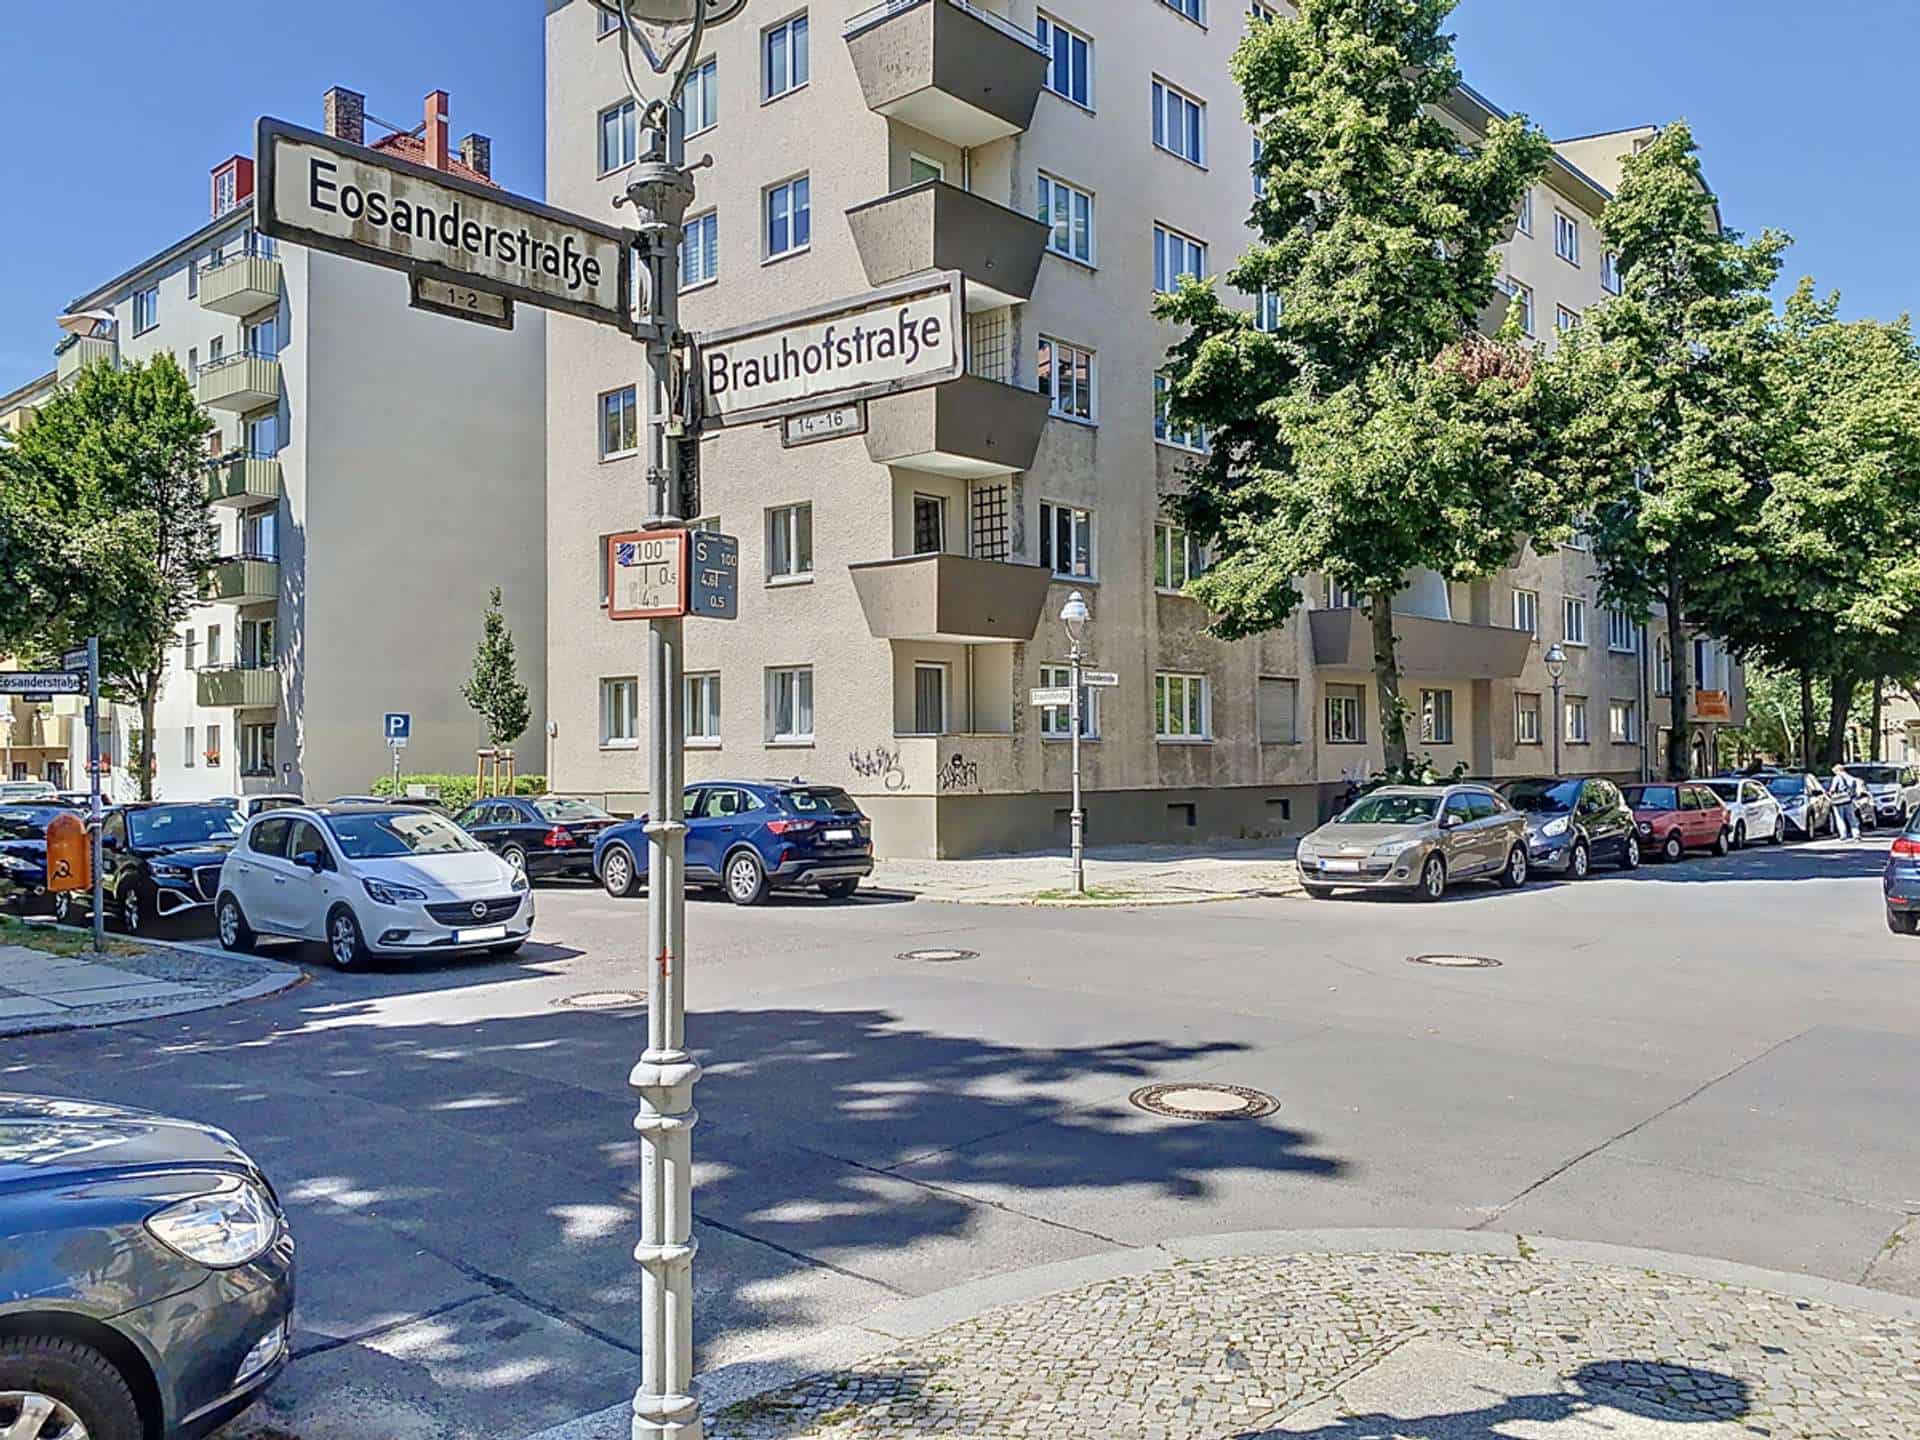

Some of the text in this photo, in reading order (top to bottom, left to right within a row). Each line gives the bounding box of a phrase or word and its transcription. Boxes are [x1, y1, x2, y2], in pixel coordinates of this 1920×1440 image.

[310, 158, 601, 290] Eosanderstraße
[708, 307, 941, 395] Brauhofstraße
[637, 541, 662, 560] 100
[696, 542, 708, 561] S
[721, 552, 737, 567] 100
[390, 716, 405, 736] P
